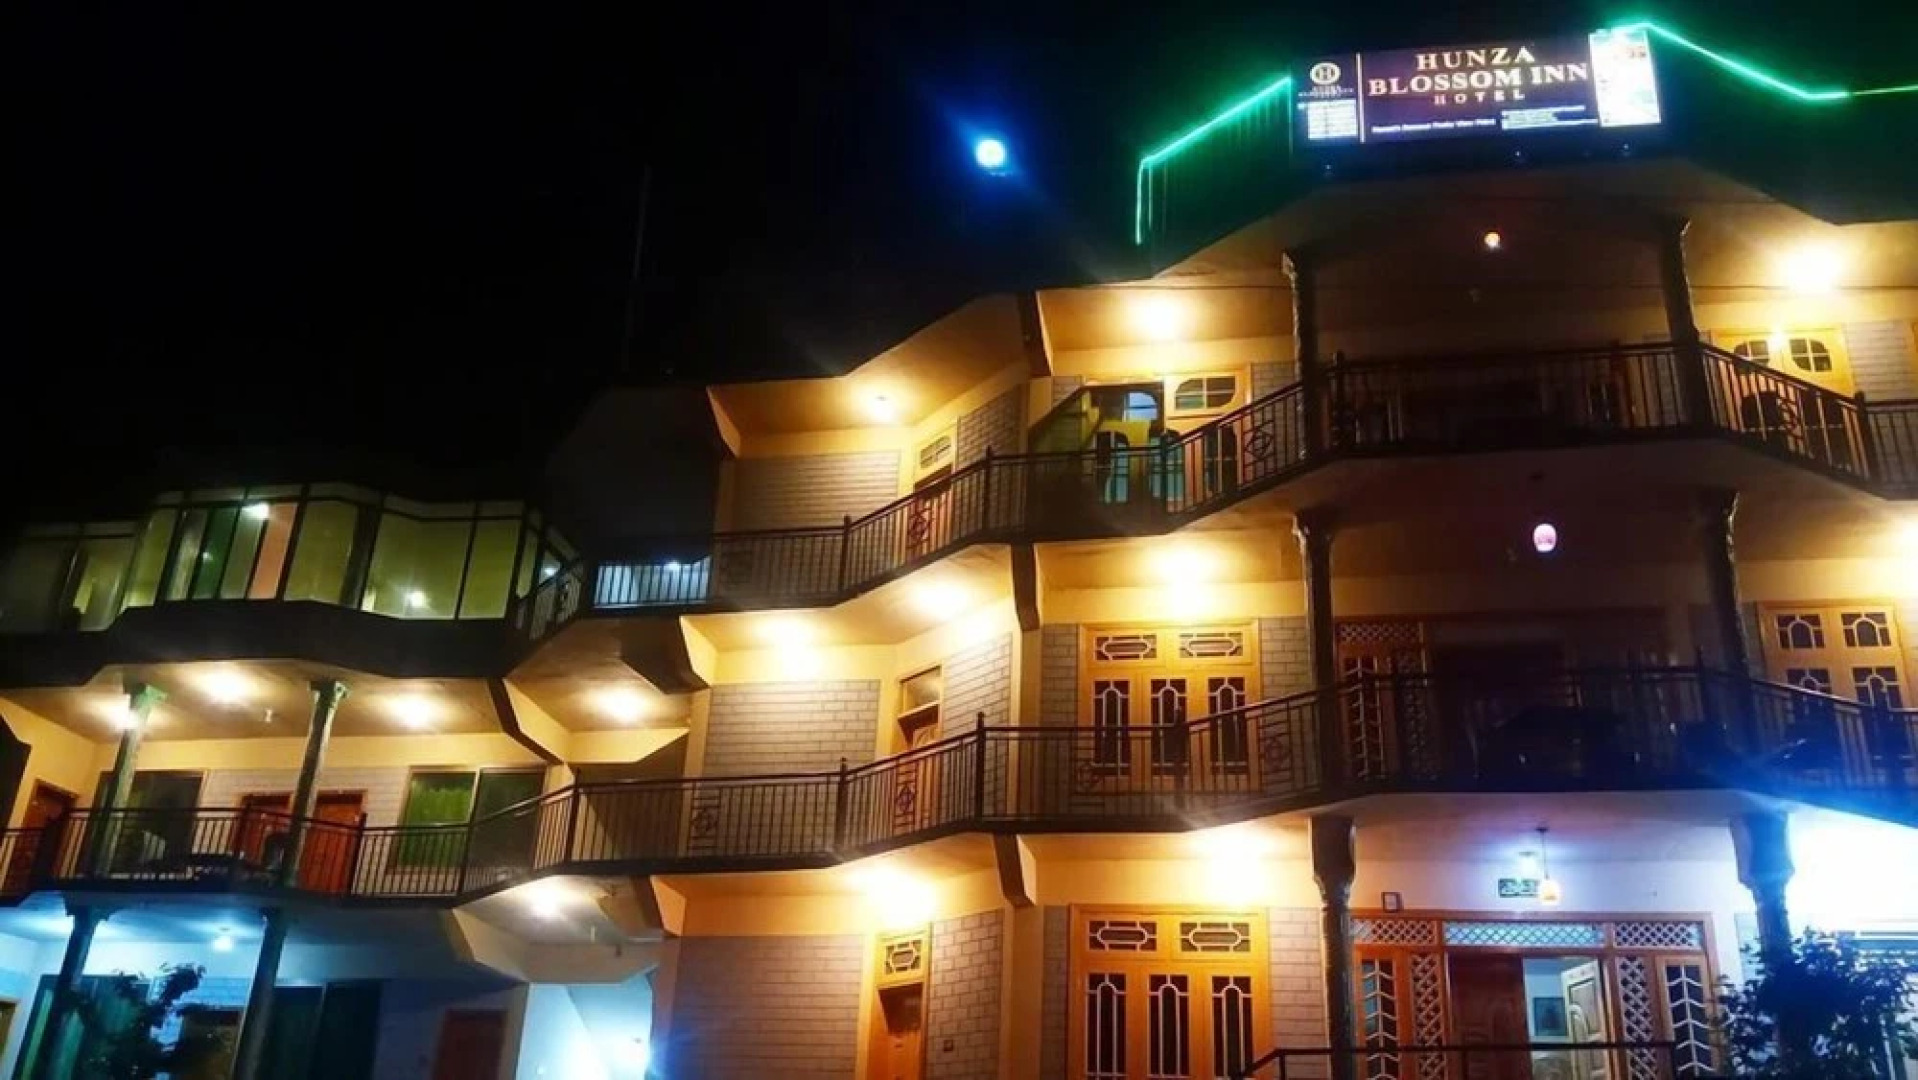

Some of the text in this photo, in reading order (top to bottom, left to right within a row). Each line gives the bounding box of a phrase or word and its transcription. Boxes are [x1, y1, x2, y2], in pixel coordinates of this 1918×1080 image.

[1416, 46, 1535, 71] HUNZA
[1368, 63, 1589, 96] BLOSSOM INN
[1434, 88, 1526, 105] HOTEL
